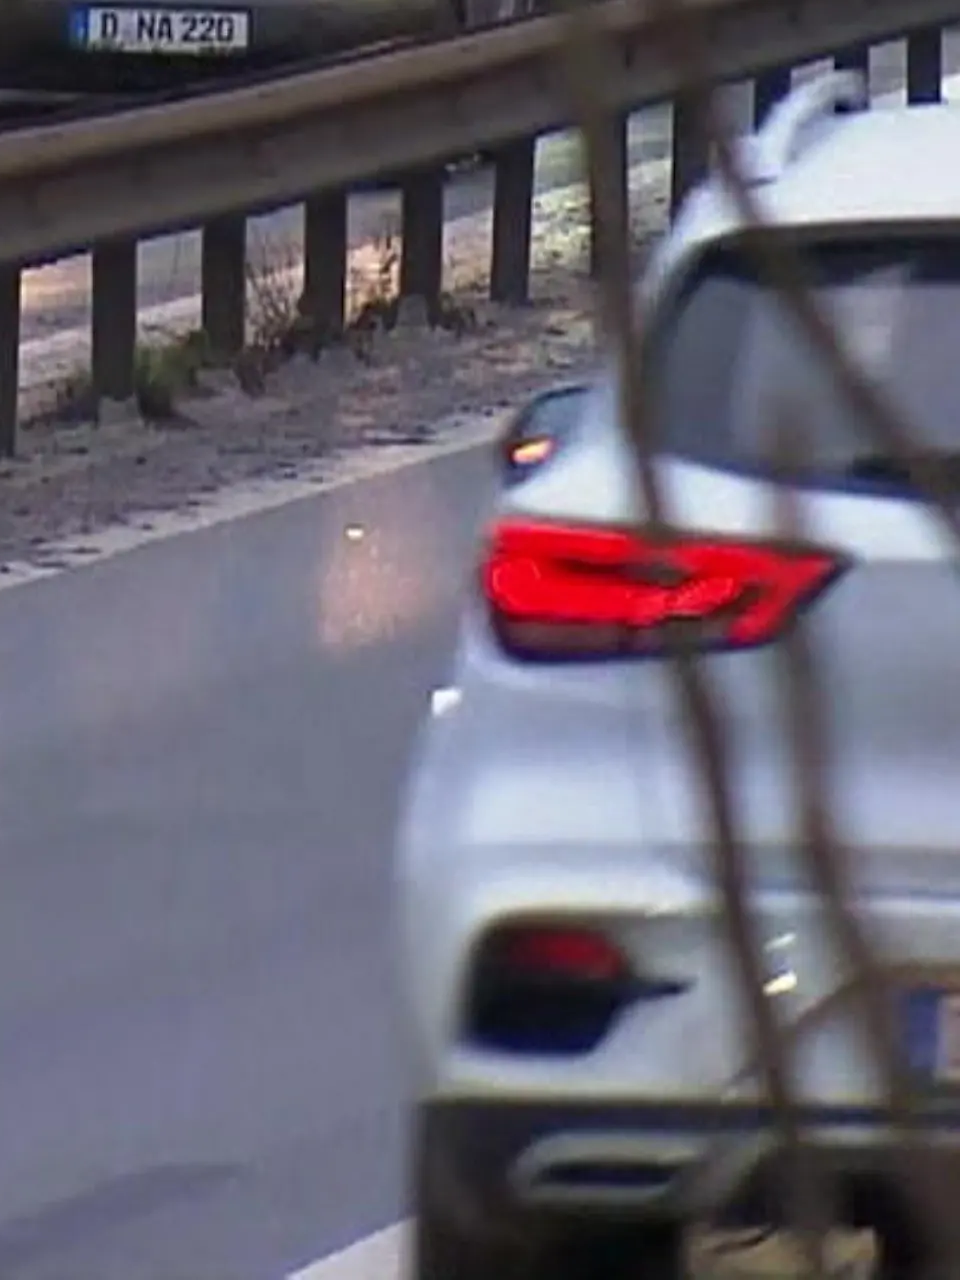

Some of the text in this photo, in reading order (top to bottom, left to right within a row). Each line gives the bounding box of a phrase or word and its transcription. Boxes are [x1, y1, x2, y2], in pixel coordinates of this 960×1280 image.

[101, 11, 235, 43] D NA 220
